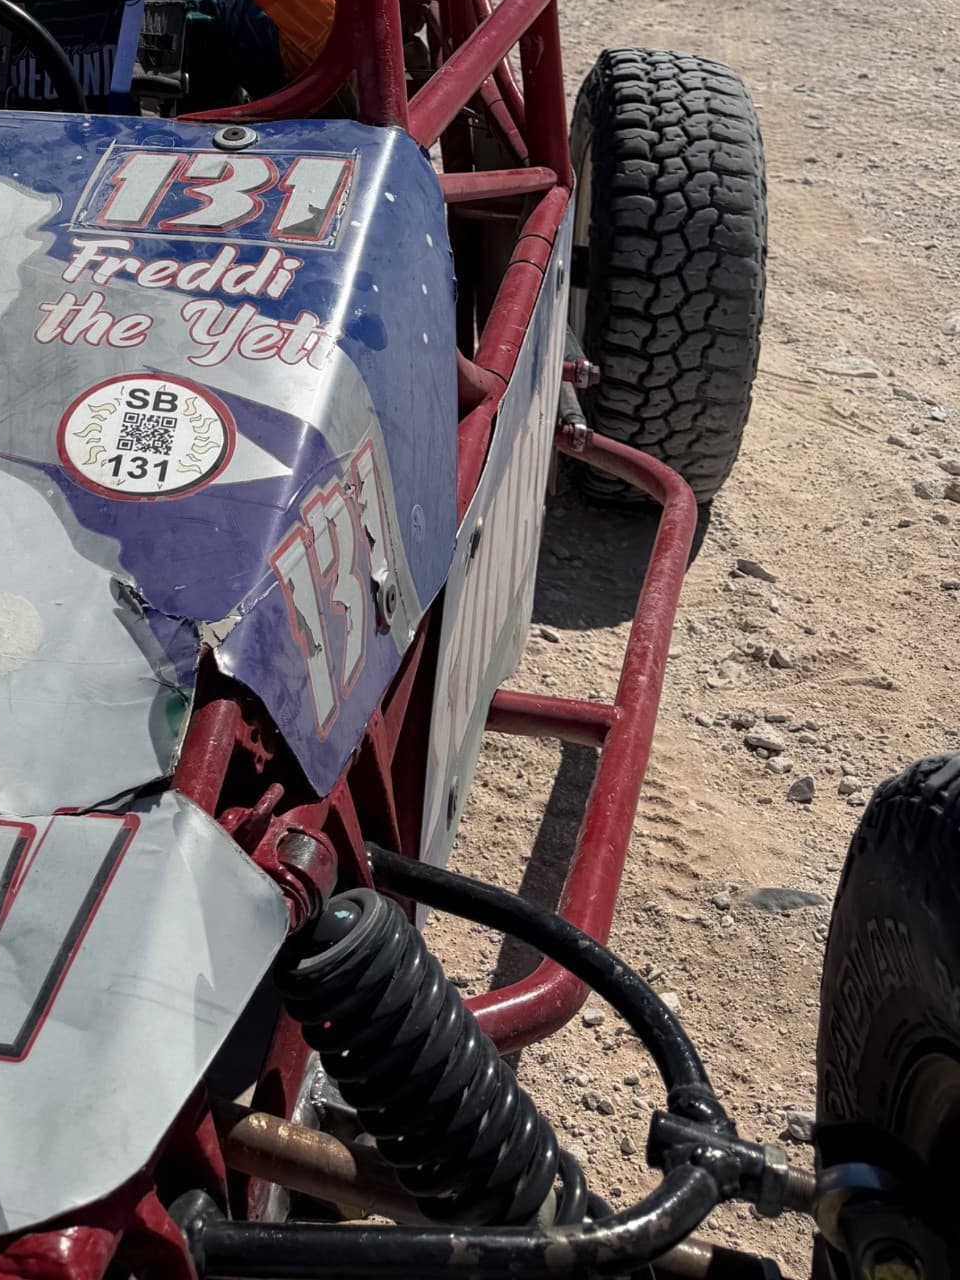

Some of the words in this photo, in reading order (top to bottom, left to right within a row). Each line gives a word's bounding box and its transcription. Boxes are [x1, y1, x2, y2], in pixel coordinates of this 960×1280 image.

[98, 152, 354, 241] 131
[62, 237, 304, 300] Freddi
[34, 291, 154, 348] the
[180, 297, 344, 371] Yeti
[125, 387, 179, 413] SB
[106, 454, 171, 483] 131
